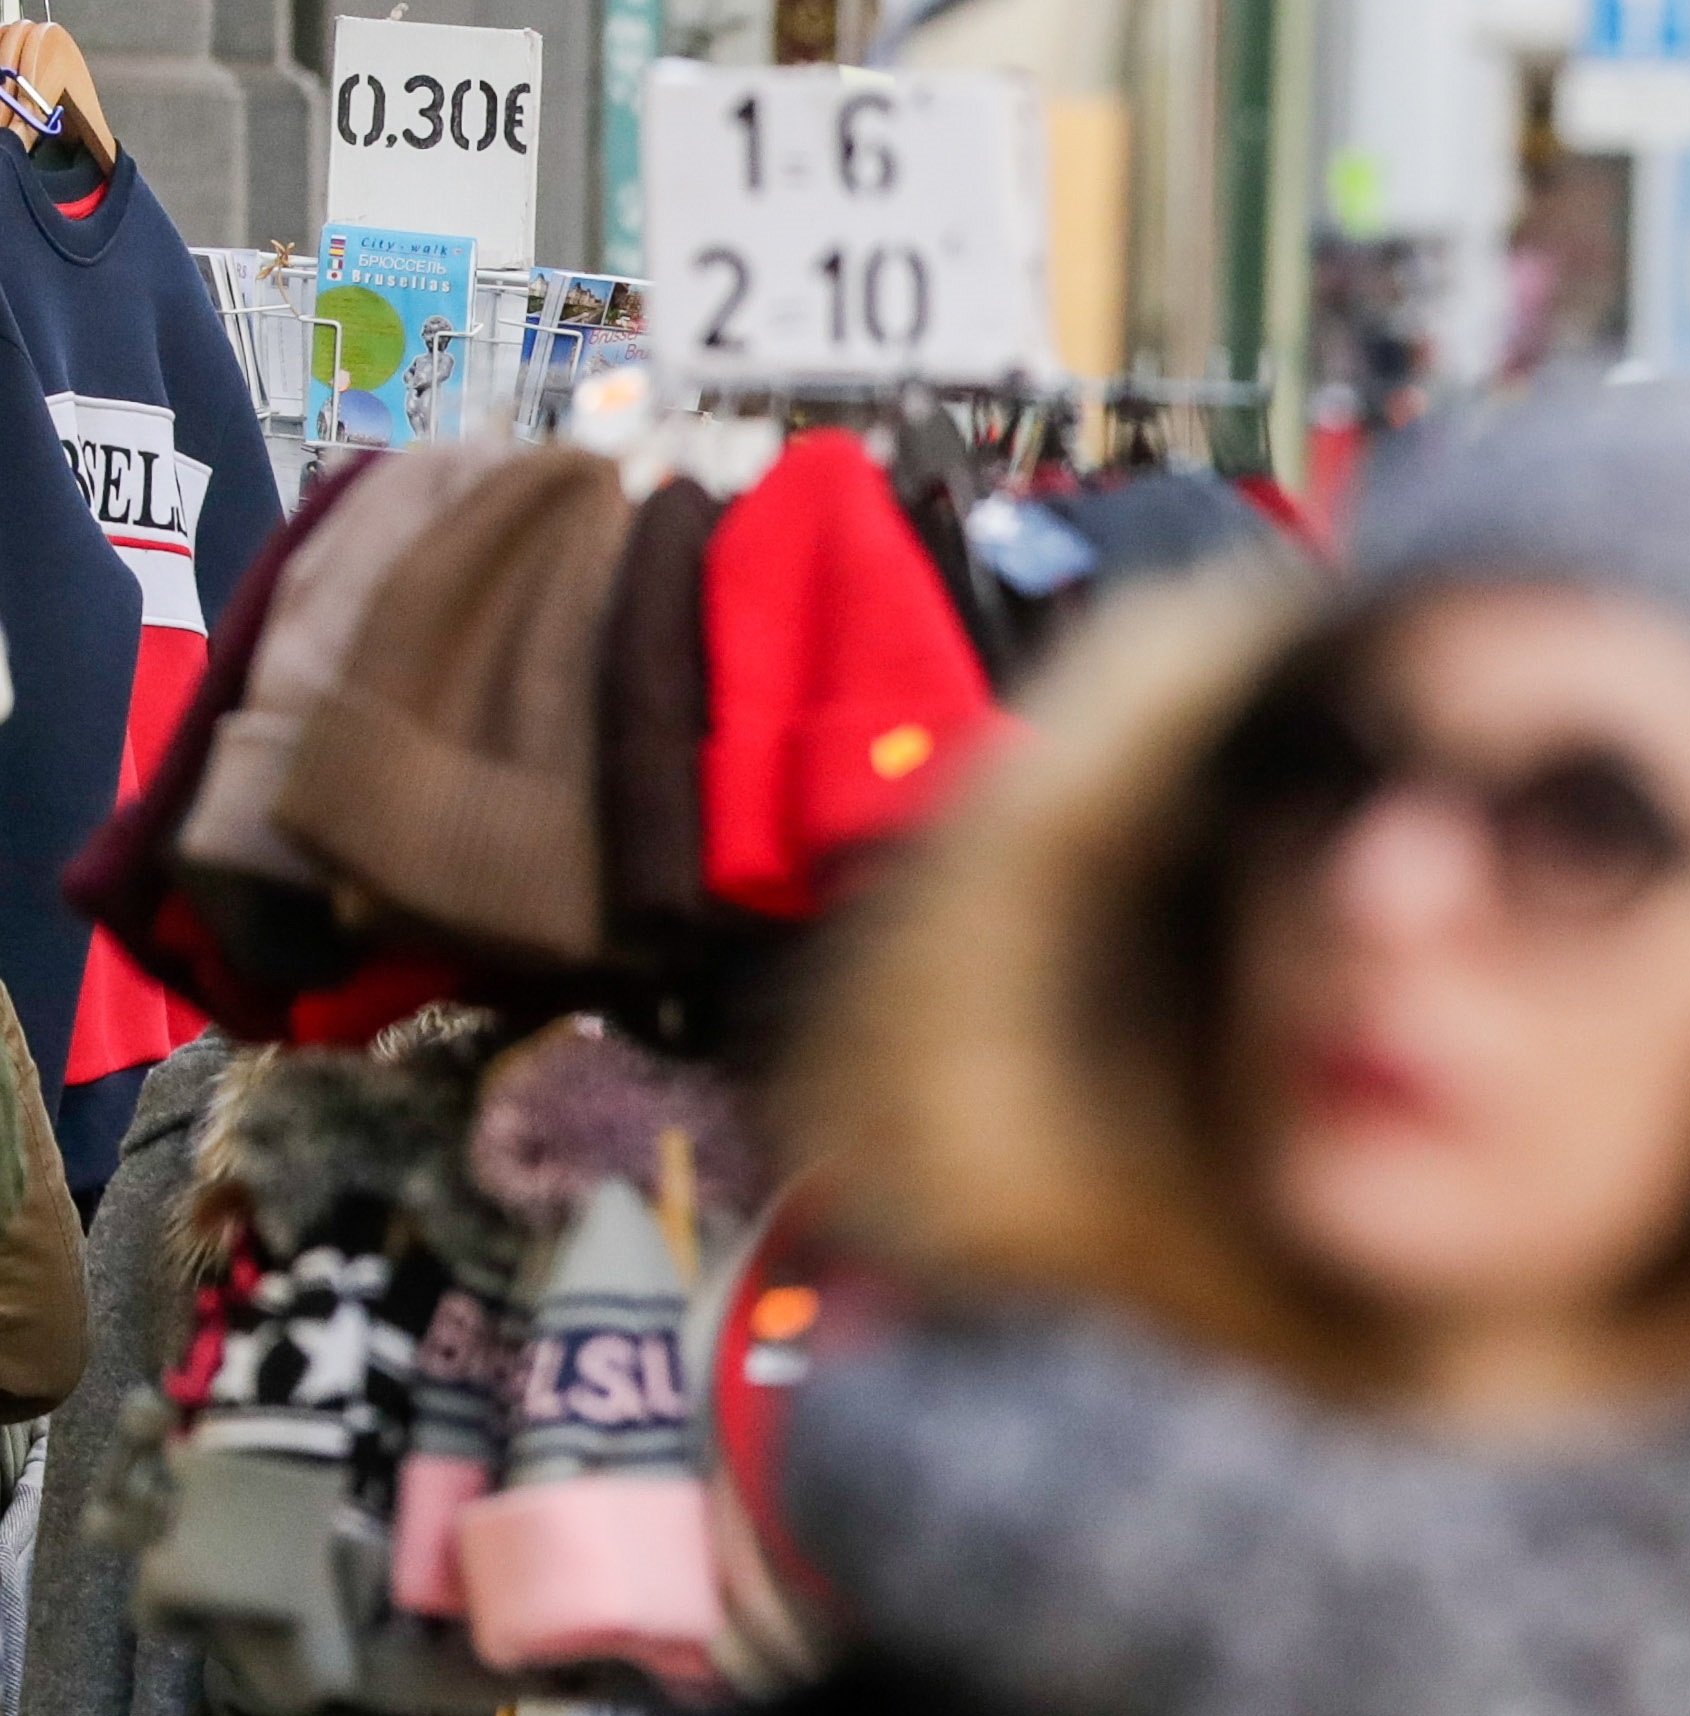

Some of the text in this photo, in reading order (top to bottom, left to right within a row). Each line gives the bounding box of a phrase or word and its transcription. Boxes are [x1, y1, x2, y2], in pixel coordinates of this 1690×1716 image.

[338, 73, 531, 155] 0,30€
[728, 92, 898, 194] 1 6
[358, 254, 447, 275] БРЮССЕЛЬ
[361, 237, 447, 256] City walk
[692, 244, 931, 350] 2 10
